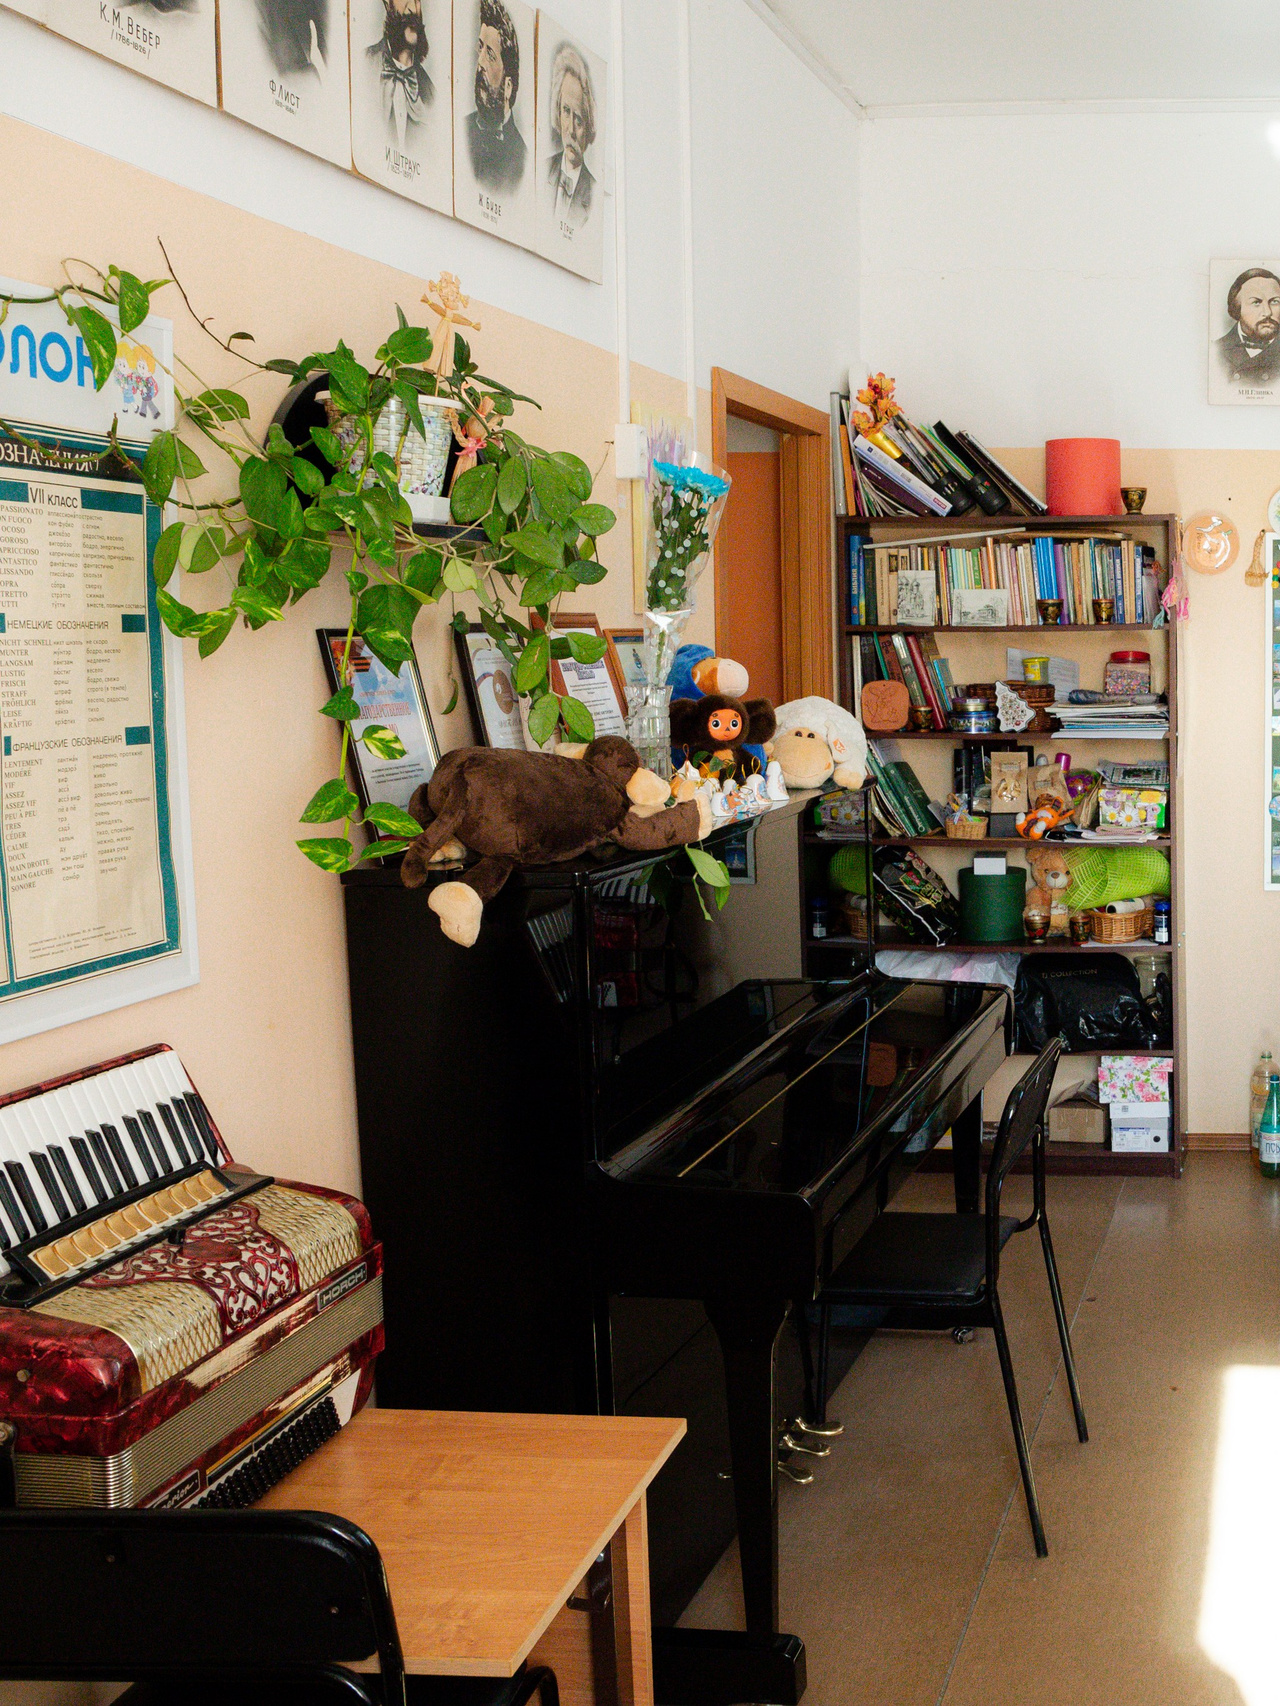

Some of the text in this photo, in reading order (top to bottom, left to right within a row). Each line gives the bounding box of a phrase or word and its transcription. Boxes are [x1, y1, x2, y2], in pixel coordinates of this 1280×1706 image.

[100, 4, 160, 49] К. М. ВЕБЕР
[278, 84, 300, 108] ЛИСТ
[394, 150, 420, 176] ШТРАУС
[30, 487, 78, 508] VII КЛАСС
[7, 620, 108, 630] НЕМЕЦКИЕ ОБОЗНАЧЕНИЯ
[13, 735, 122, 752] ФРАНЦУЗСКИЕ ОБОЗНАЧЕНИЯ
[4, 758, 43, 769] LENTEMENT
[4, 791, 25, 799] ASSEZ
[4, 801, 25, 809] ASSEZ
[7, 842, 28, 852] CALME
[8, 853, 26, 862] DOUX
[9, 863, 27, 872] MAIN
[27, 858, 50, 869] DROITE
[10, 874, 27, 883] MAIN
[28, 868, 54, 879] GAUCHE
[11, 882, 36, 892] SONORE
[1050, 968, 1098, 978] COLLECTION
[323, 1269, 364, 1304] HORCH
